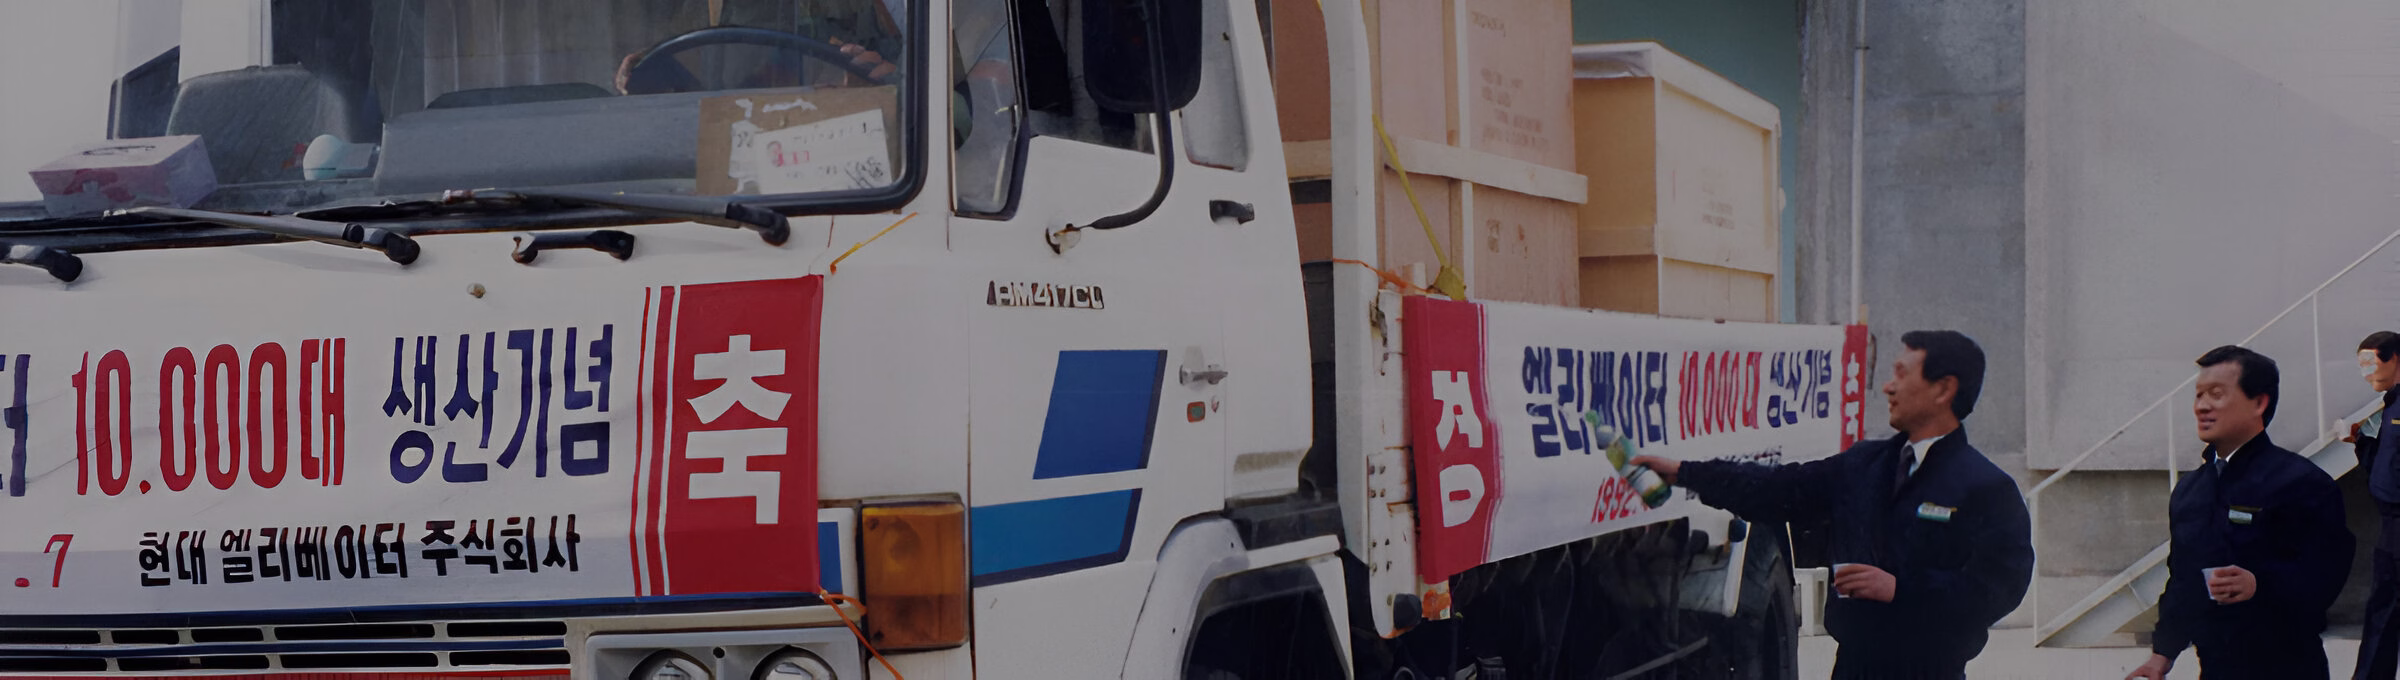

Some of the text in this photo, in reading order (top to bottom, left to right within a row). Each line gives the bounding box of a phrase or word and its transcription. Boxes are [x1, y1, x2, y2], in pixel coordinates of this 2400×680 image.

[71, 337, 346, 496] 10.000대
[383, 323, 613, 484] 생산기념
[686, 334, 791, 525] 축
[1431, 370, 1486, 528] 경
[1522, 346, 1669, 458] 엘리베이터
[1767, 349, 1832, 428] 생산기념
[1844, 351, 1861, 443] 축
[138, 530, 208, 587] 현대
[219, 522, 409, 584] 엘리베이터
[420, 513, 581, 577] 주식회사
